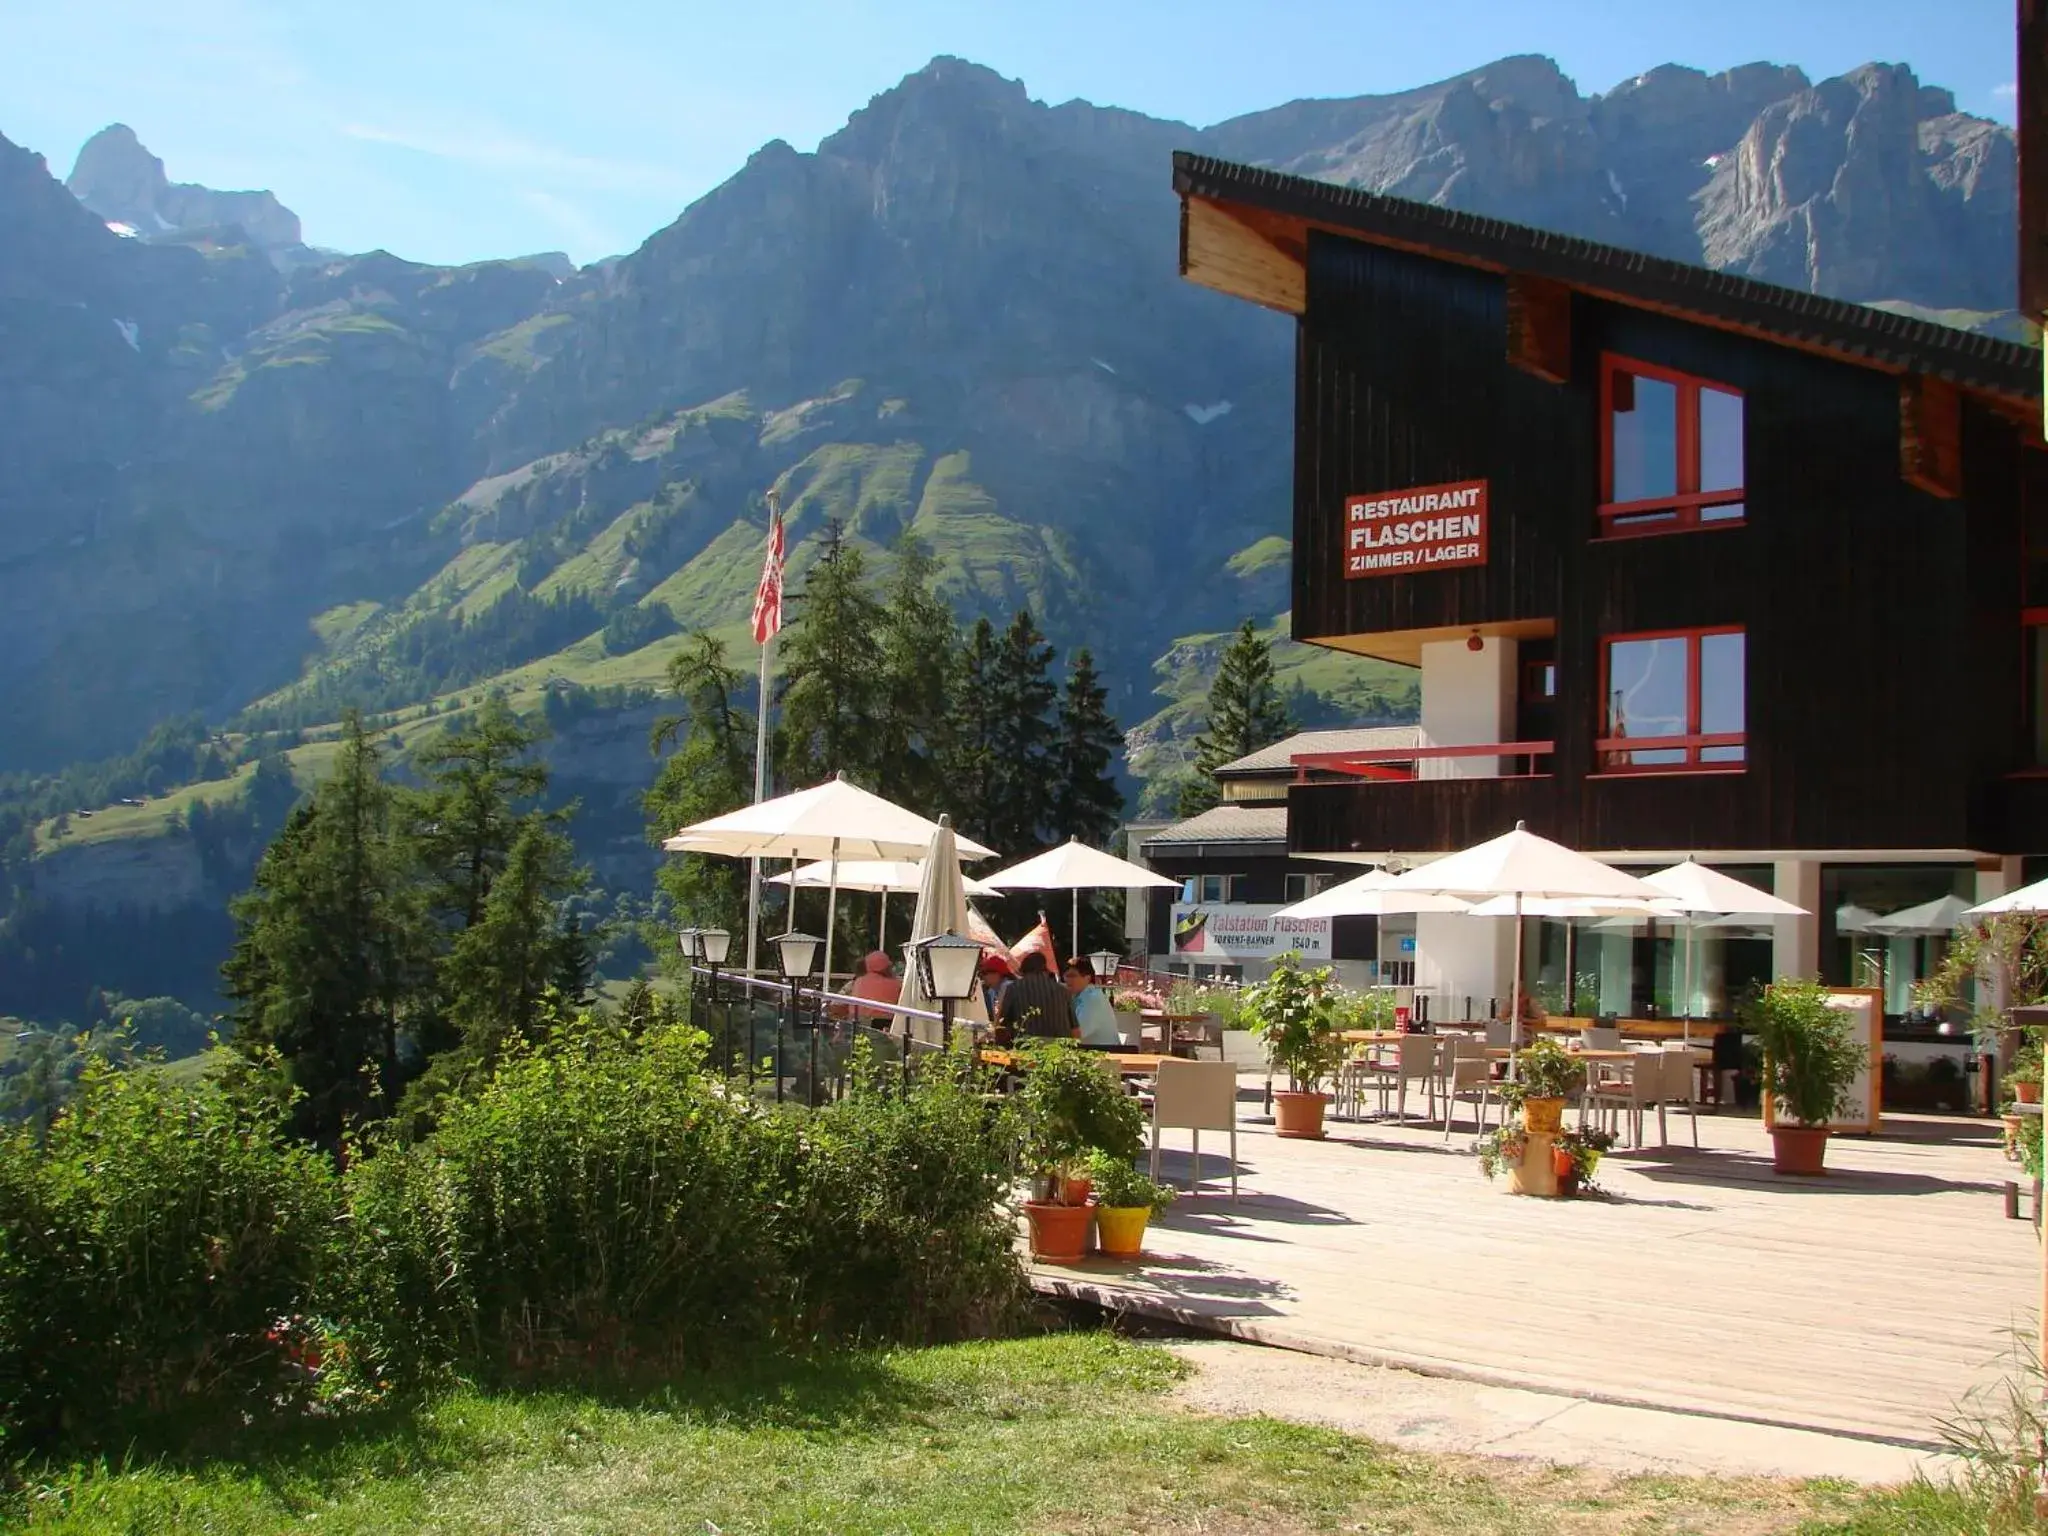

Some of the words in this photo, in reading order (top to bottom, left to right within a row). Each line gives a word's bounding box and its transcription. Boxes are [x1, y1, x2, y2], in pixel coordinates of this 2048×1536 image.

[1351, 488, 1480, 521] RESTAURANT
[1351, 514, 1480, 549] FLASCHEN
[1212, 914, 1268, 932] Talstation
[1273, 916, 1327, 933] Flaschen
[1292, 936, 1310, 949] 1540
